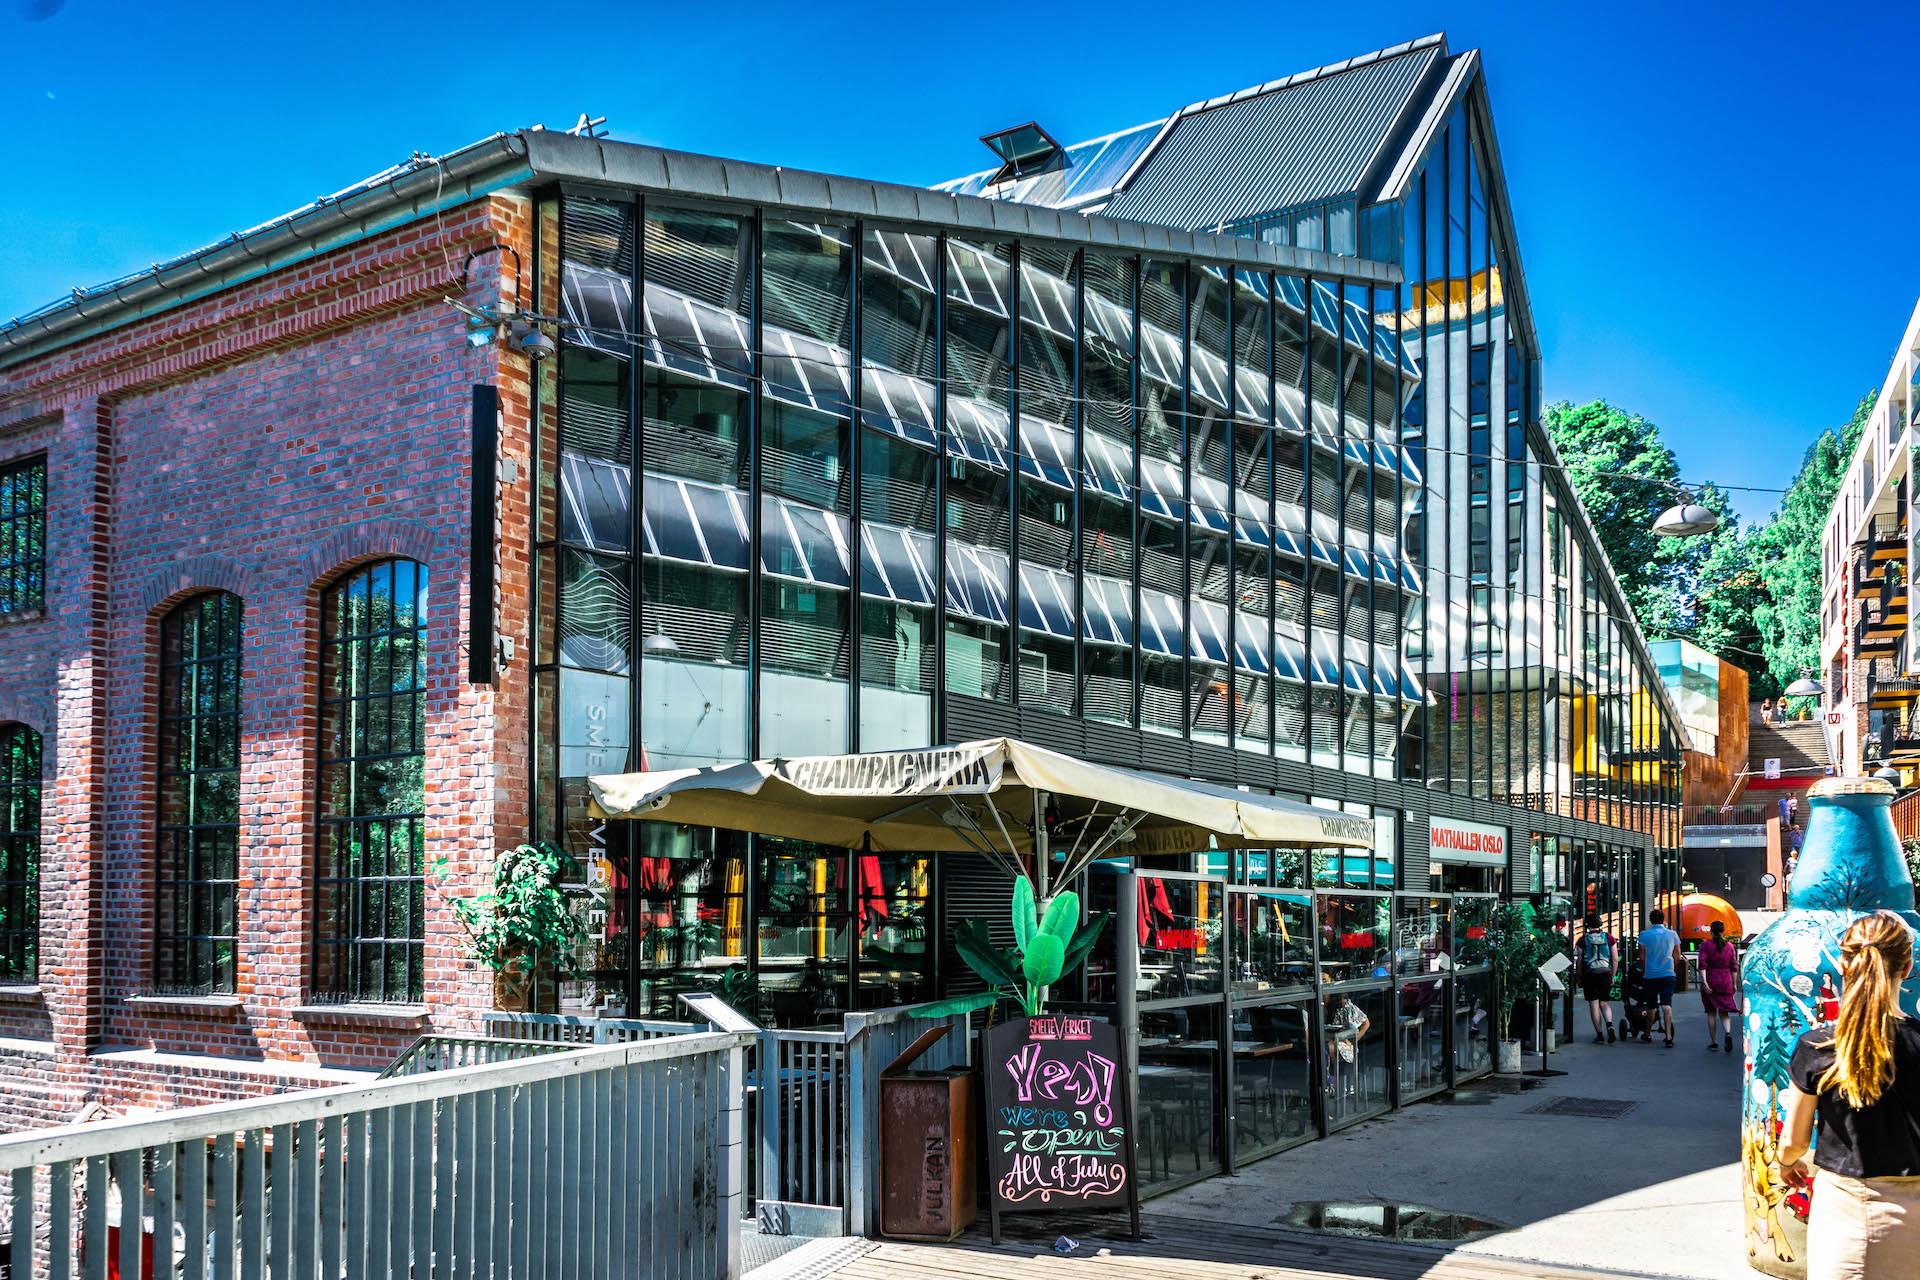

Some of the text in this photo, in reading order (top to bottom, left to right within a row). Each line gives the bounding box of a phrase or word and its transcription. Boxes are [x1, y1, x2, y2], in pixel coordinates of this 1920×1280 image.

[793, 750, 990, 790] CHAMPAGNERIA
[1431, 827, 1503, 854] MATHALLEN OSLO
[588, 824, 607, 946] VERKET
[1005, 1042, 1116, 1127] Yes!
[1004, 1153, 1109, 1193] All of July
